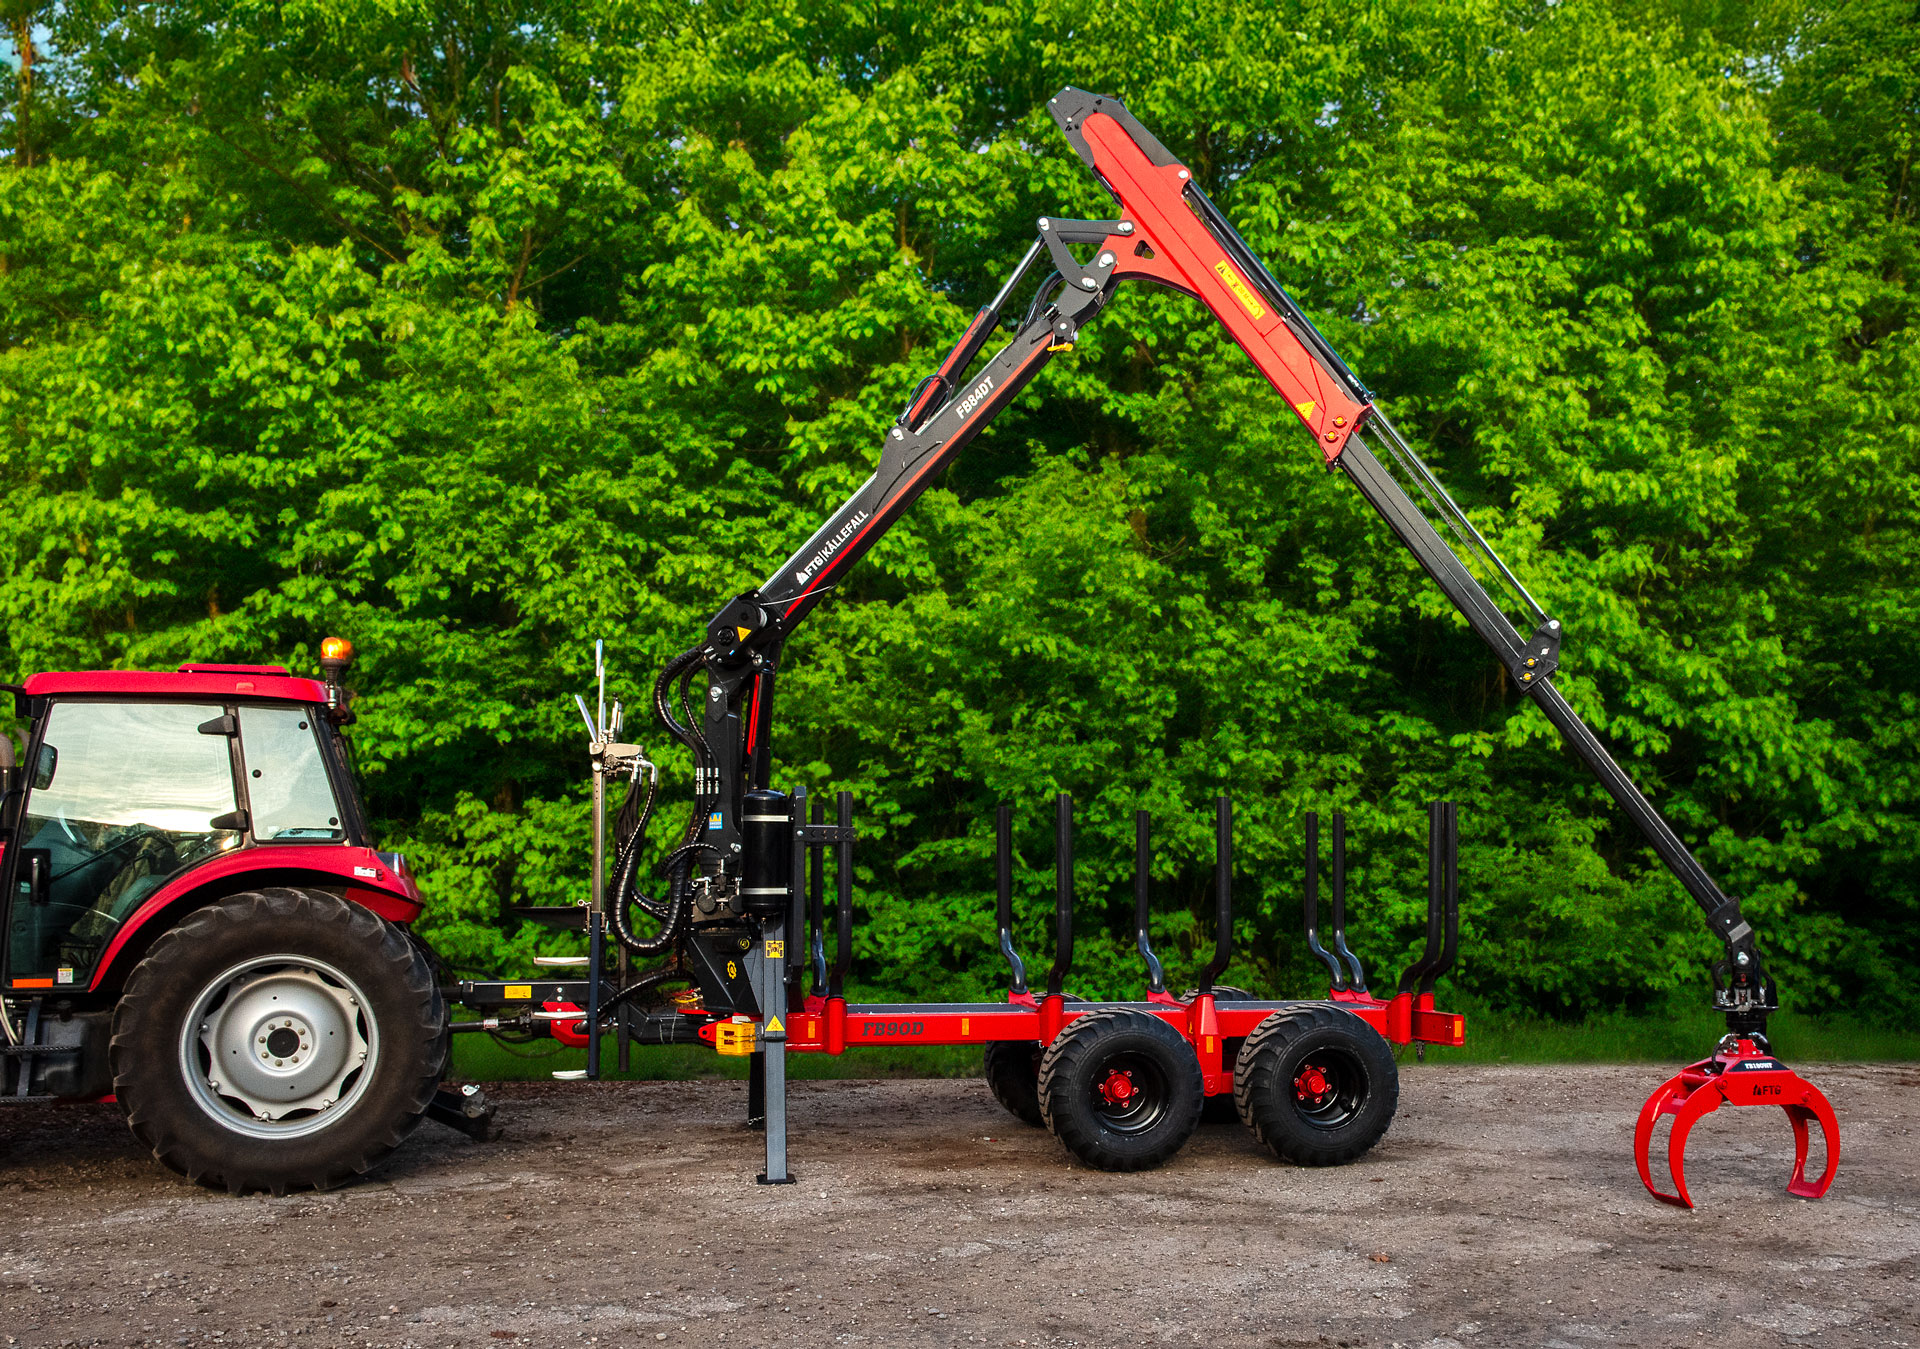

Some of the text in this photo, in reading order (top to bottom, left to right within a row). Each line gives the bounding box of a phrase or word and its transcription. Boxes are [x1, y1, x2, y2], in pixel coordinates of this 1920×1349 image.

[956, 375, 994, 419] FB84DT
[862, 1021, 925, 1036] FB90D
[1762, 1085, 1781, 1095] FTG
